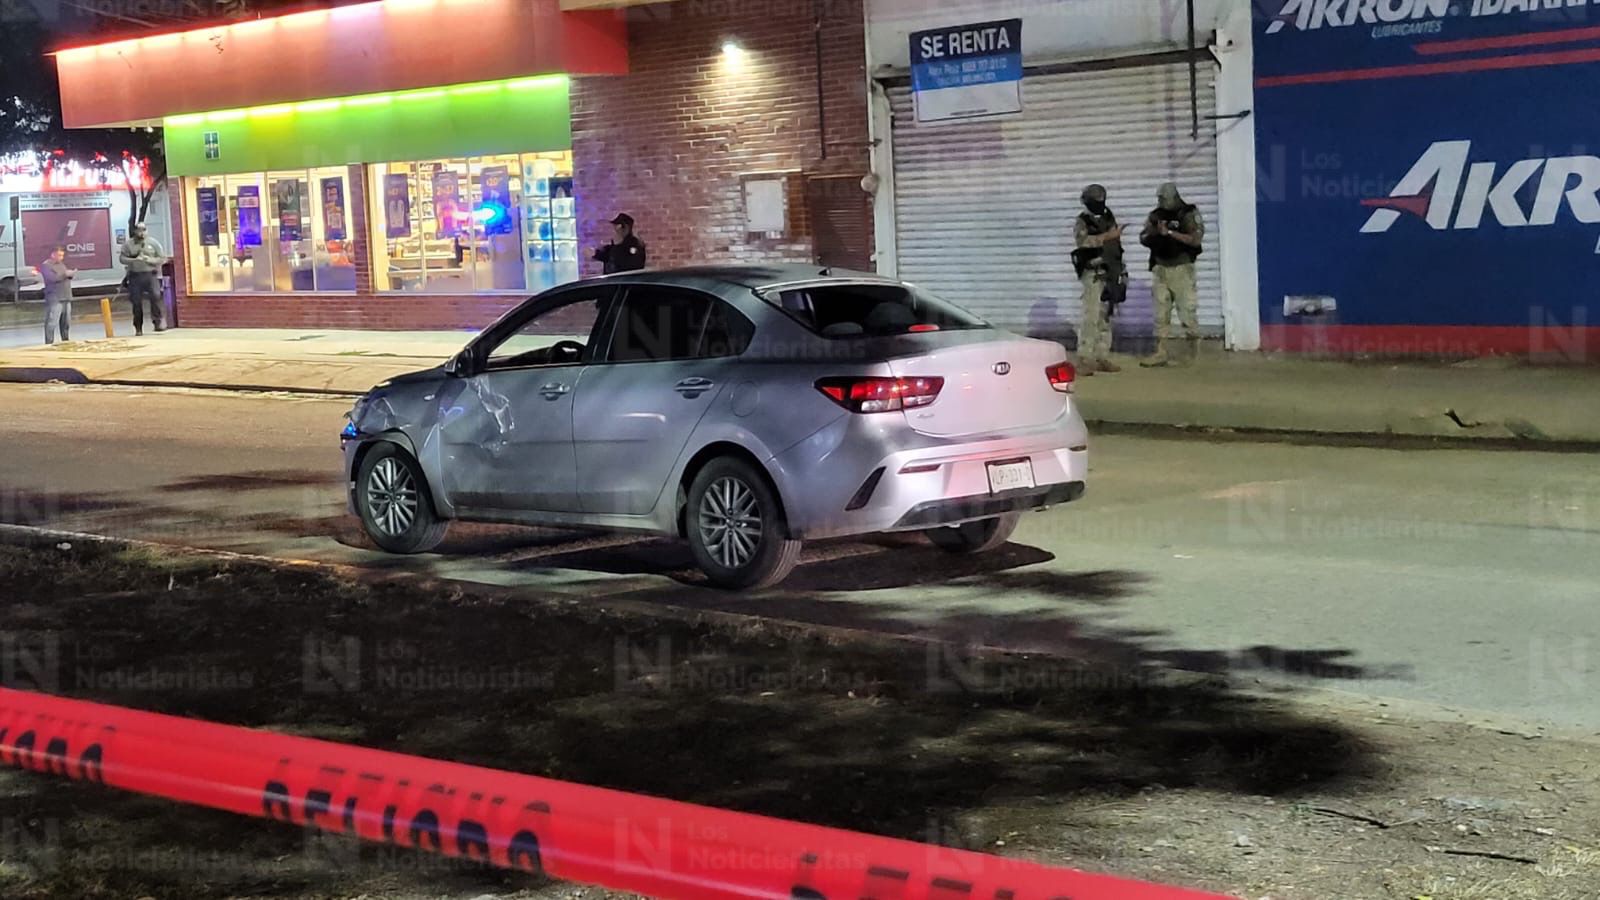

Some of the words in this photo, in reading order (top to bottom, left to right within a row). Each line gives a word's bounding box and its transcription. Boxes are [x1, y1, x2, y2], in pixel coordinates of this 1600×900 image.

[920, 35, 945, 59] SE
[949, 27, 1010, 55] RENTA
[66, 243, 96, 252] ONE
